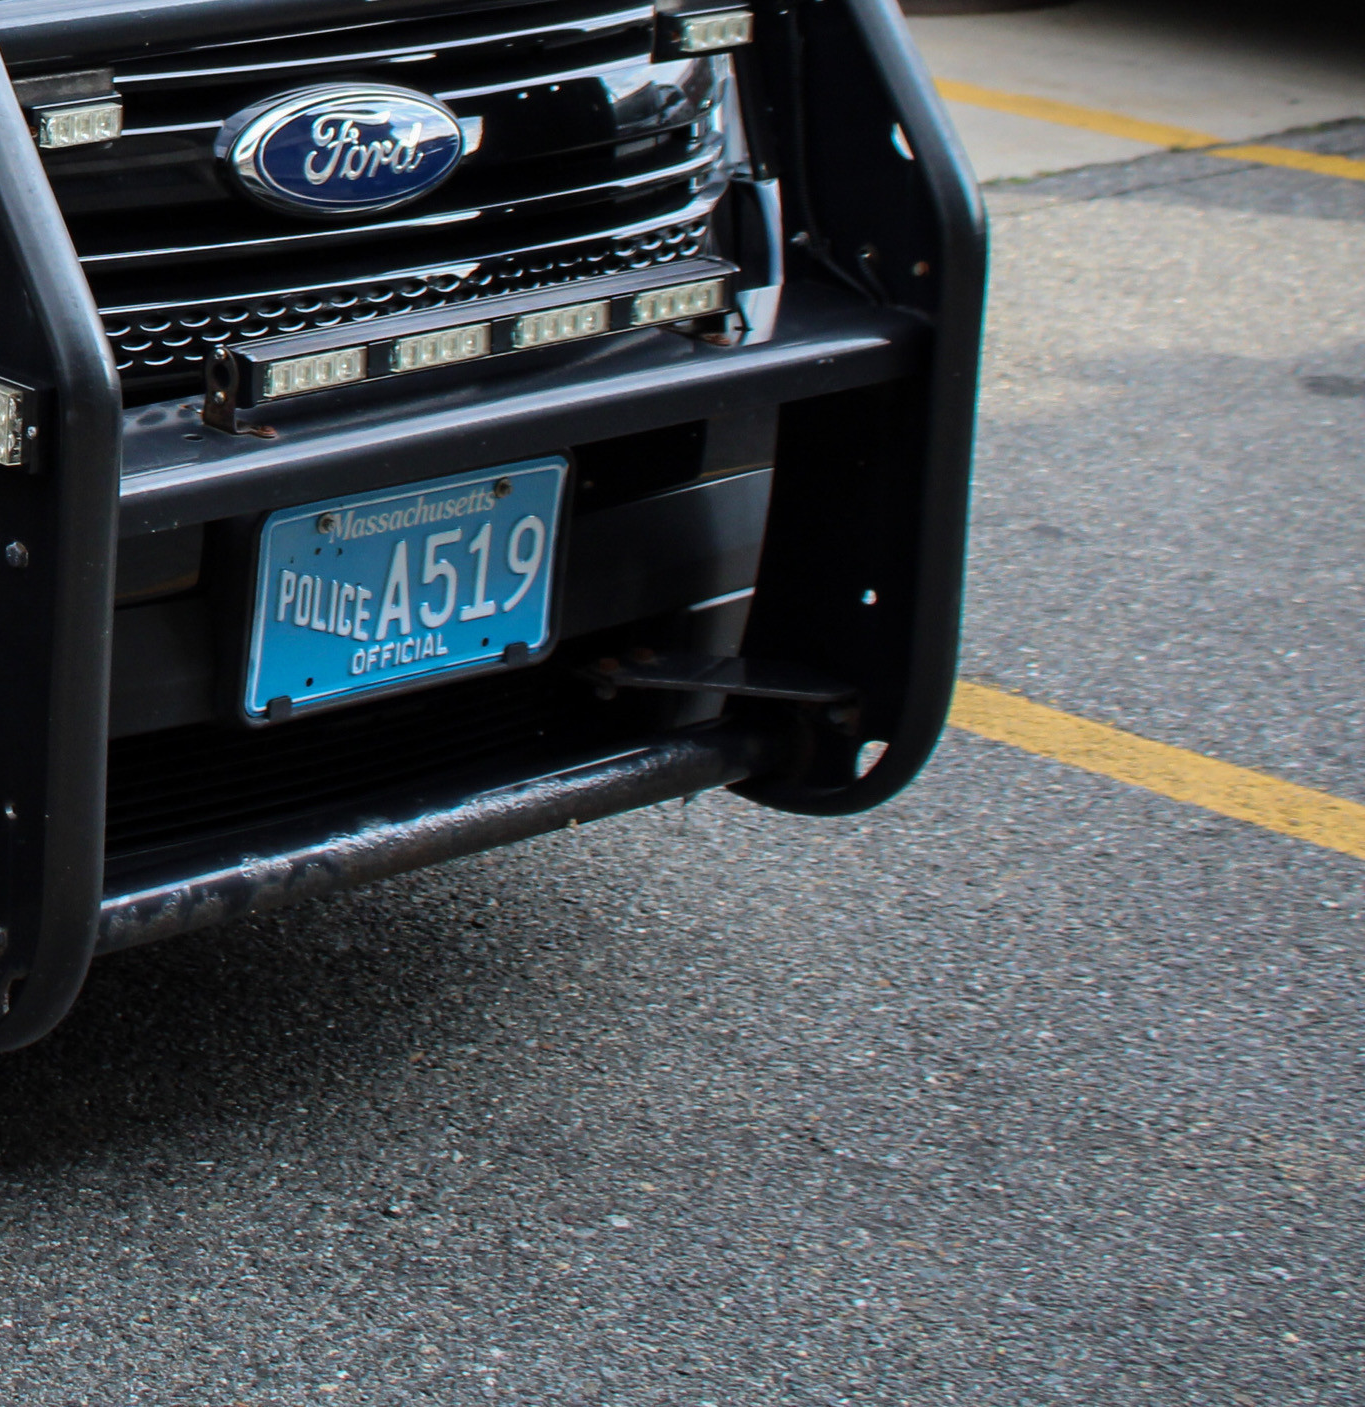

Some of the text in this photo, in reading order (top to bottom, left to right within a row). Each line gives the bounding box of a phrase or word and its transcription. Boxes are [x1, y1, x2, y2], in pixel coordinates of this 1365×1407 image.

[304, 110, 425, 185] Ford
[329, 488, 497, 544] Massachusetts
[277, 515, 545, 641] POLICE A519
[351, 633, 448, 675] OFFICIAL
